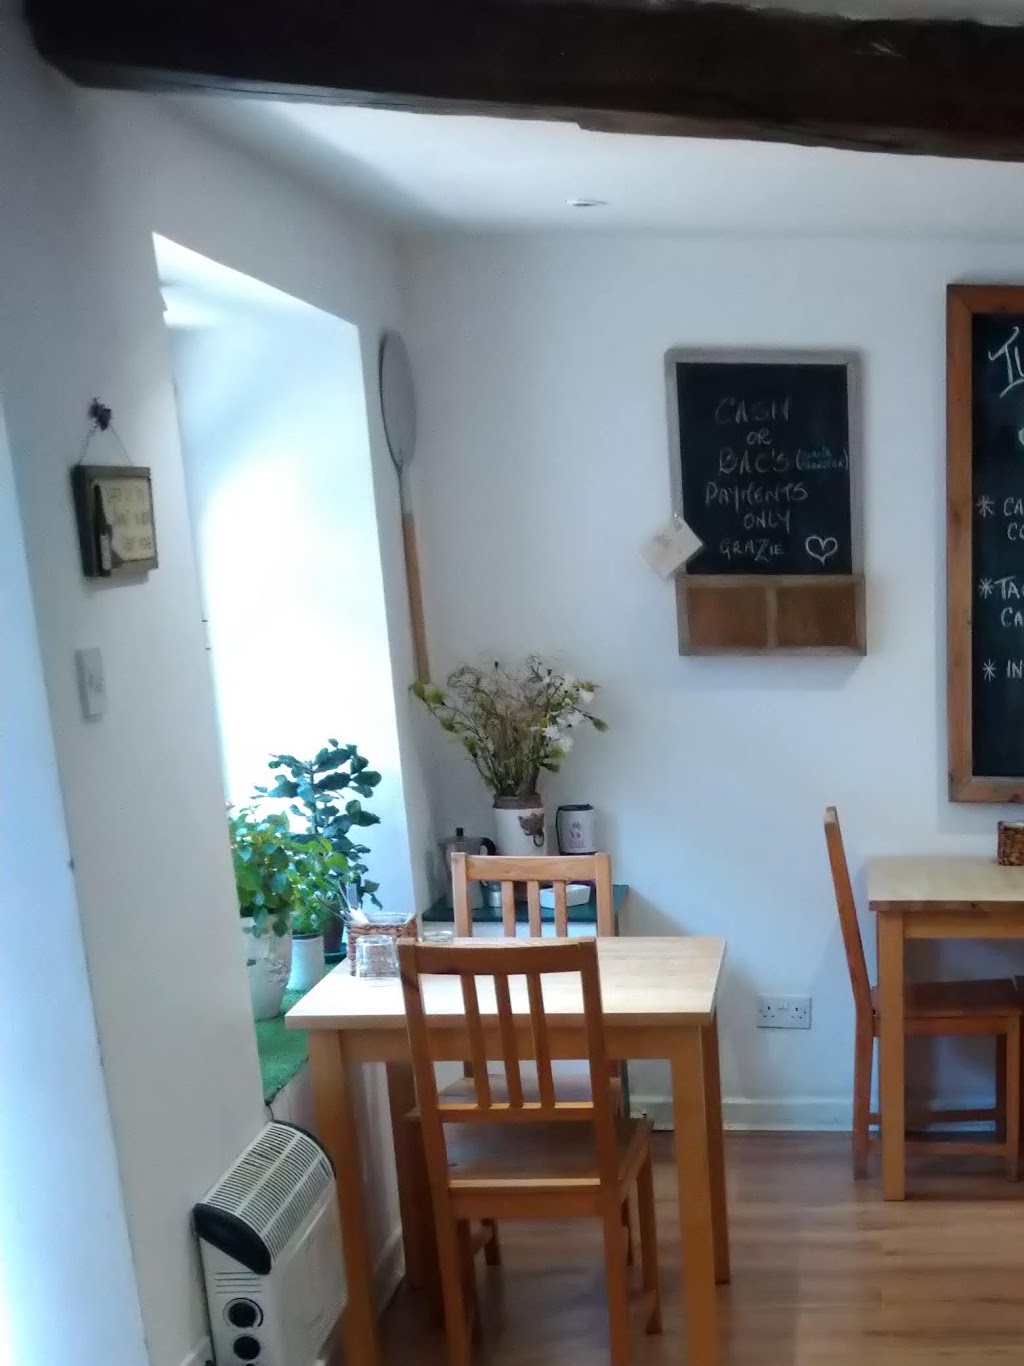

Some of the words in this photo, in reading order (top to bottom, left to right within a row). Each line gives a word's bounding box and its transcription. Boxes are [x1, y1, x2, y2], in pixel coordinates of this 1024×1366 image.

[746, 427, 772, 445] OR
[705, 481, 809, 512] PAYMENTS
[743, 509, 791, 535] ONLY
[720, 537, 786, 563] GRAZIE
